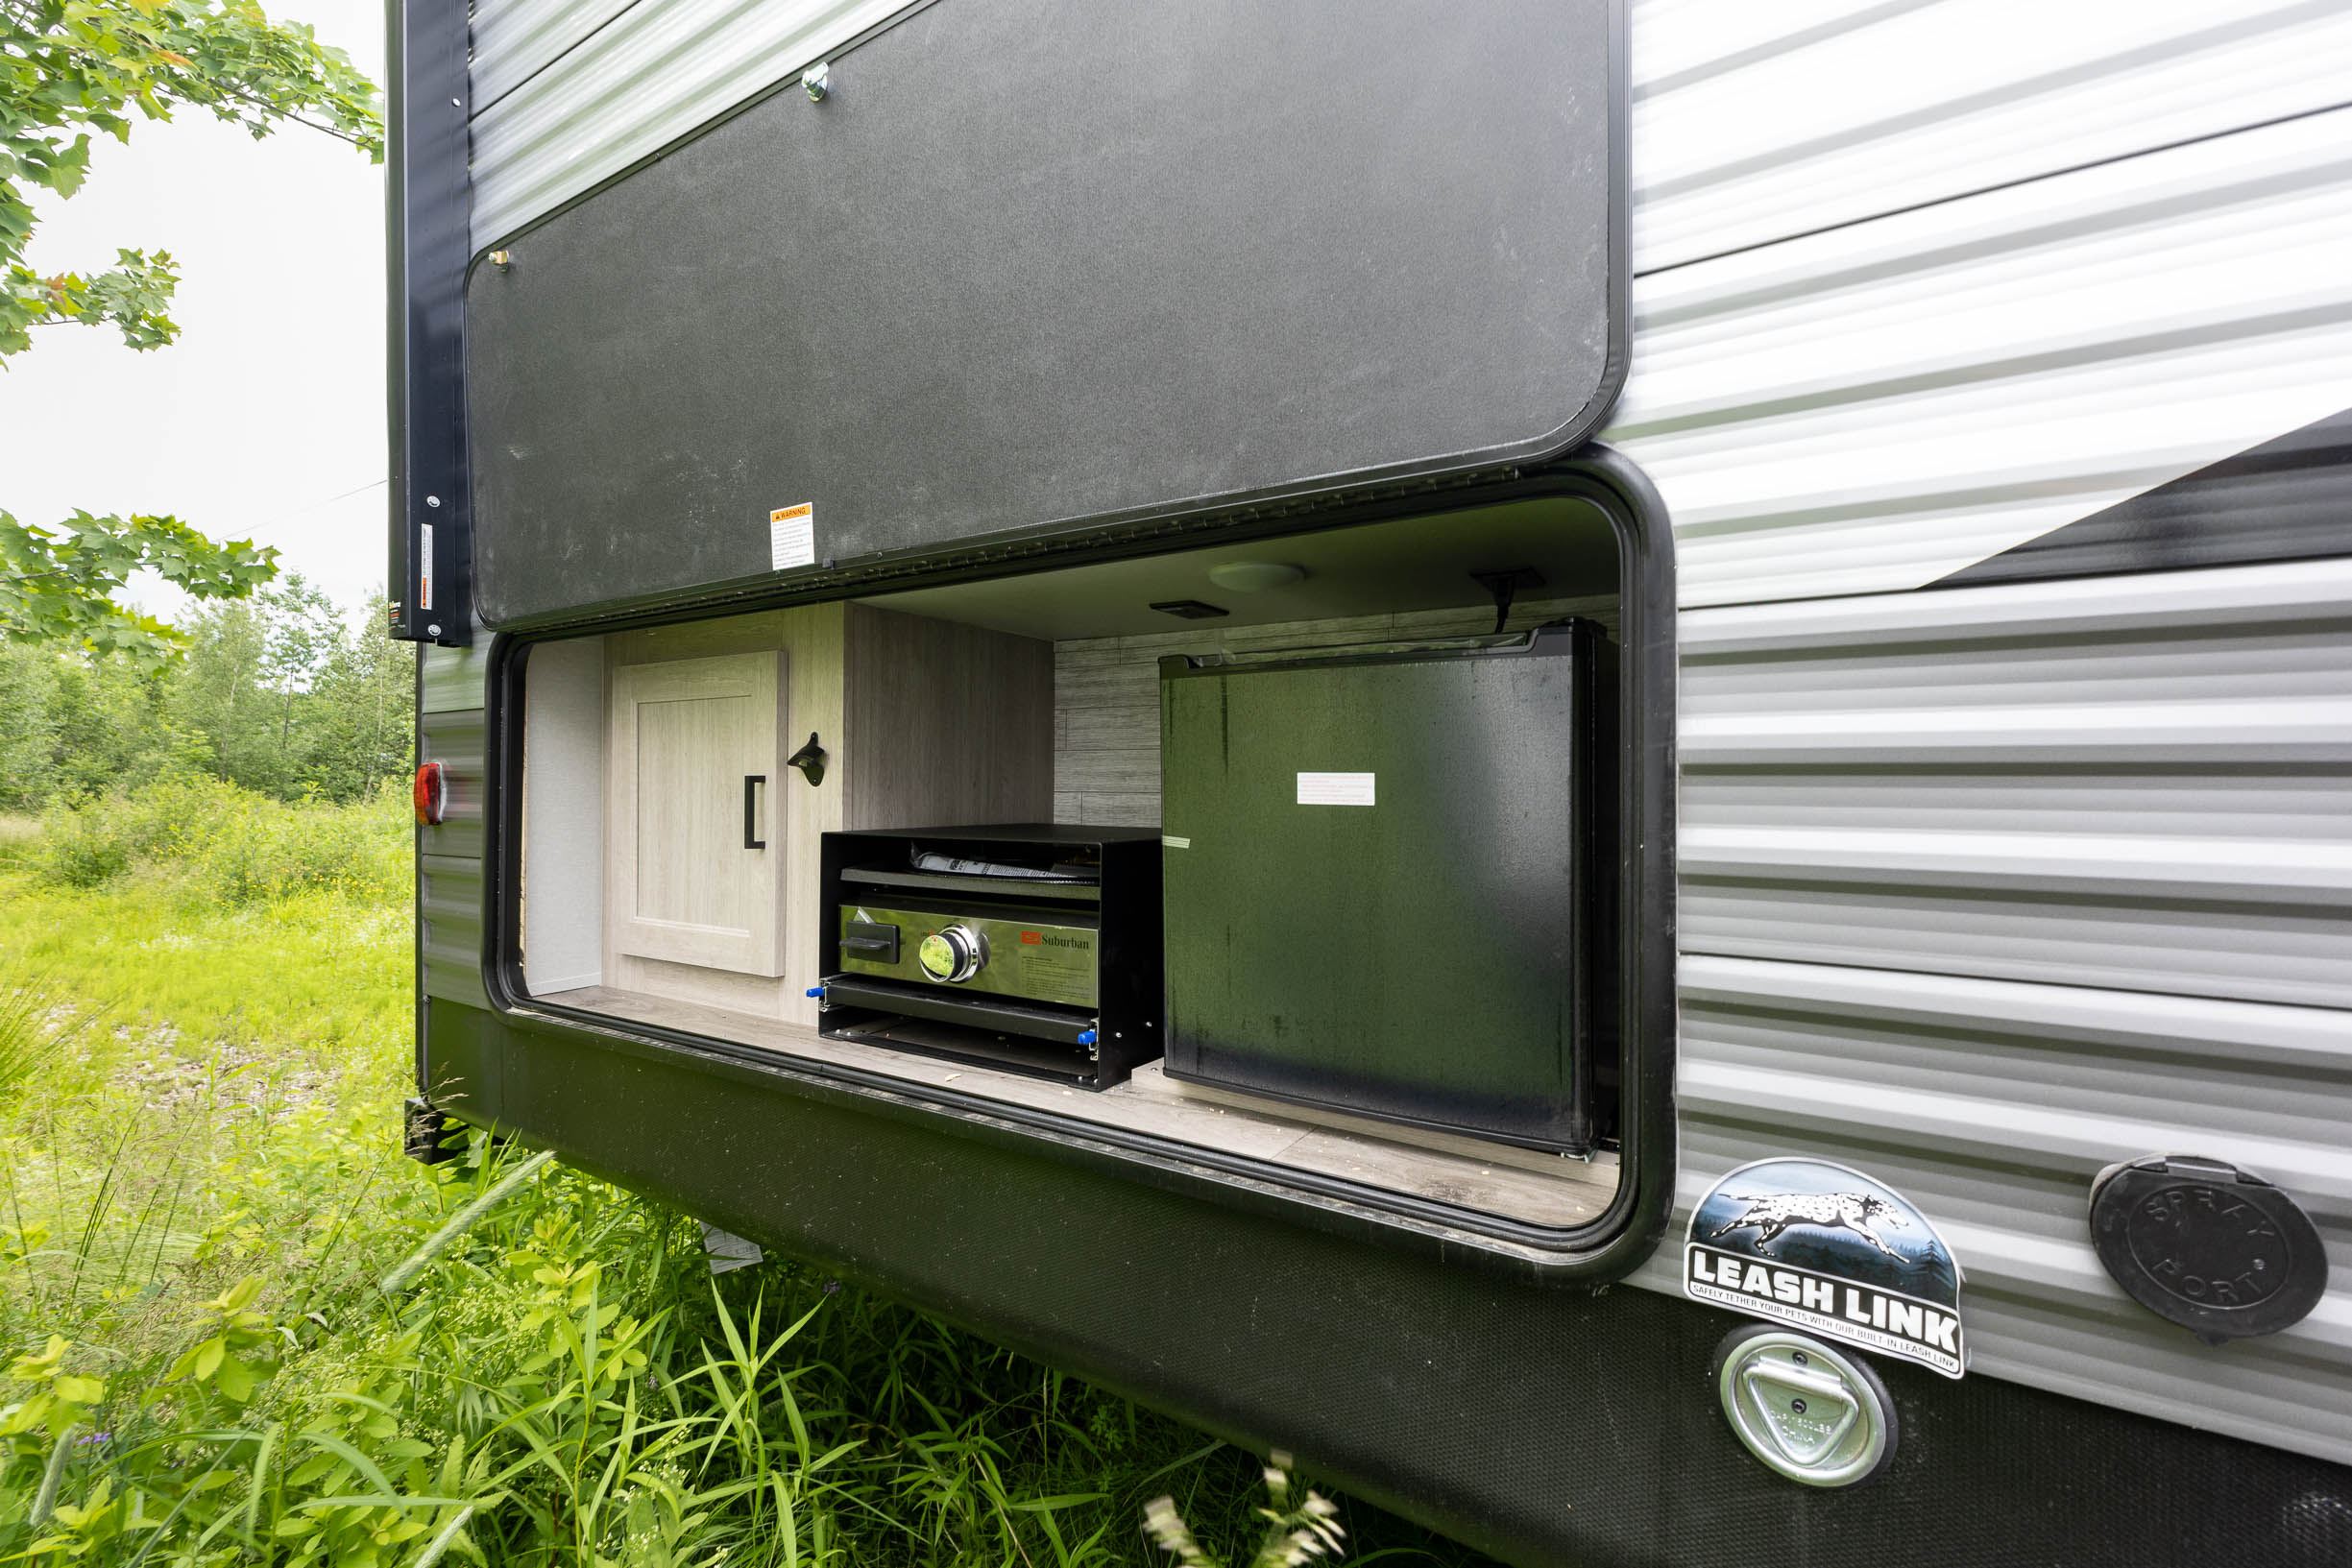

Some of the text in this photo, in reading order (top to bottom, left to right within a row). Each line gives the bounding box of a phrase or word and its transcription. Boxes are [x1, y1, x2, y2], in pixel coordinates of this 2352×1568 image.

[781, 507, 806, 519] WARNING
[1041, 934, 1089, 950] Suburban
[2146, 1190, 2275, 1236] SPRAY
[2152, 1257, 2262, 1302] PORT
[1693, 1250, 1958, 1355] LEASH LINK
[1693, 1284, 1724, 1301] SAFELY
[1725, 1290, 1758, 1308] TETHER
[1758, 1298, 1783, 1315] YOUR
[1784, 1306, 1807, 1322] PETS
[1809, 1313, 1833, 1329] WITH
[1835, 1320, 1855, 1336] OUR
[1899, 1340, 1931, 1360] LEASH
[1933, 1352, 1955, 1369] LINK
